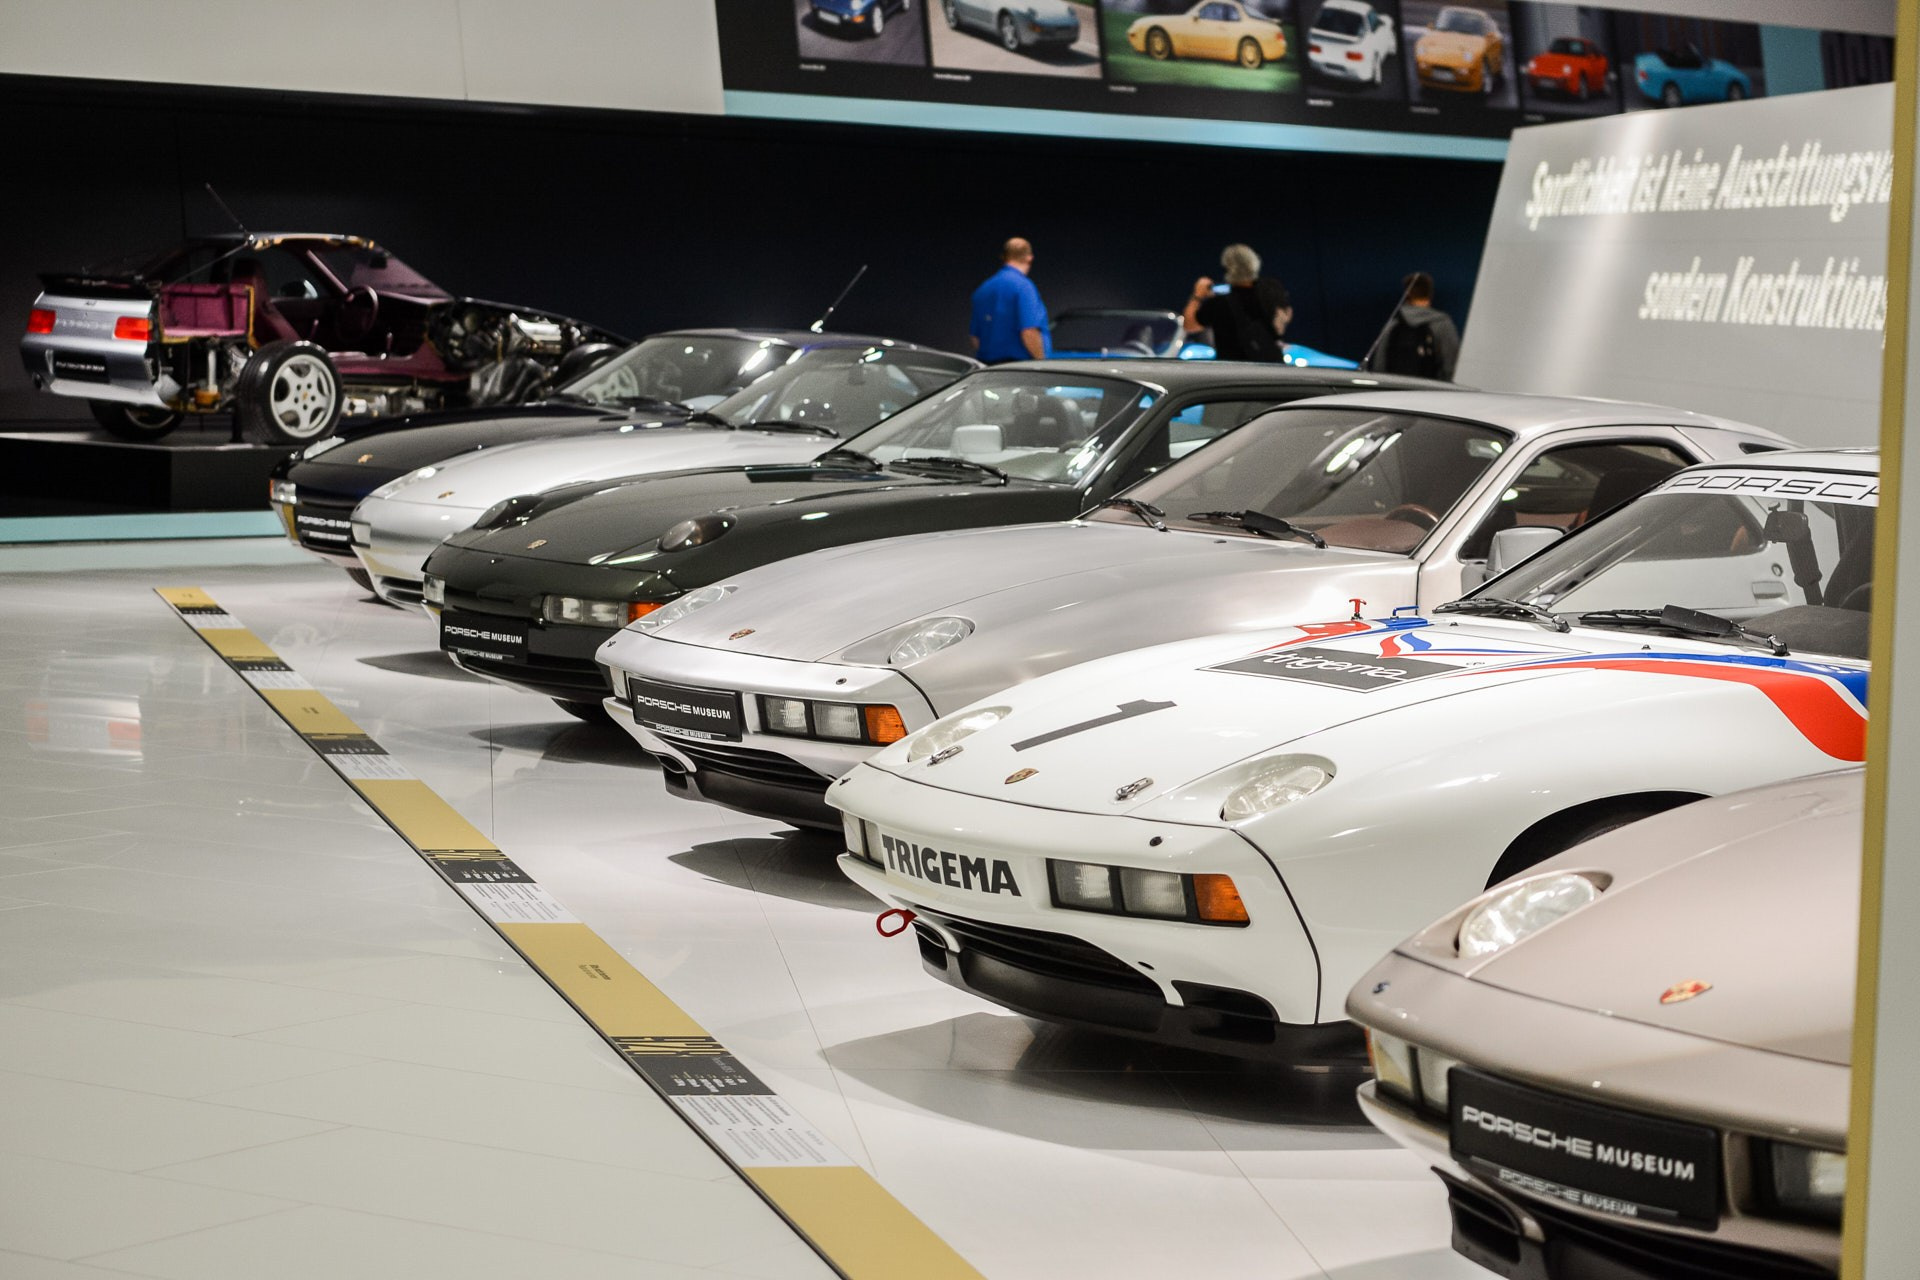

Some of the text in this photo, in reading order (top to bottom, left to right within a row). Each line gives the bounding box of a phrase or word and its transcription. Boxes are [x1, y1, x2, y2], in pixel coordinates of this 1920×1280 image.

[1631, 153, 1669, 213] ist
[1658, 149, 1721, 212] keine
[1638, 256, 1728, 322] sondern
[445, 625, 523, 644] PORSCHE MUSEUM
[1263, 652, 1409, 682] trigema
[637, 695, 731, 720] PORSCHE MUSEUM
[1010, 699, 1178, 752] 1
[881, 833, 1022, 897] TRIGEMA
[1462, 1105, 1695, 1182] PORSCHE MUSEUM
[1499, 1168, 1638, 1217] PORSCHE MUSEUM
